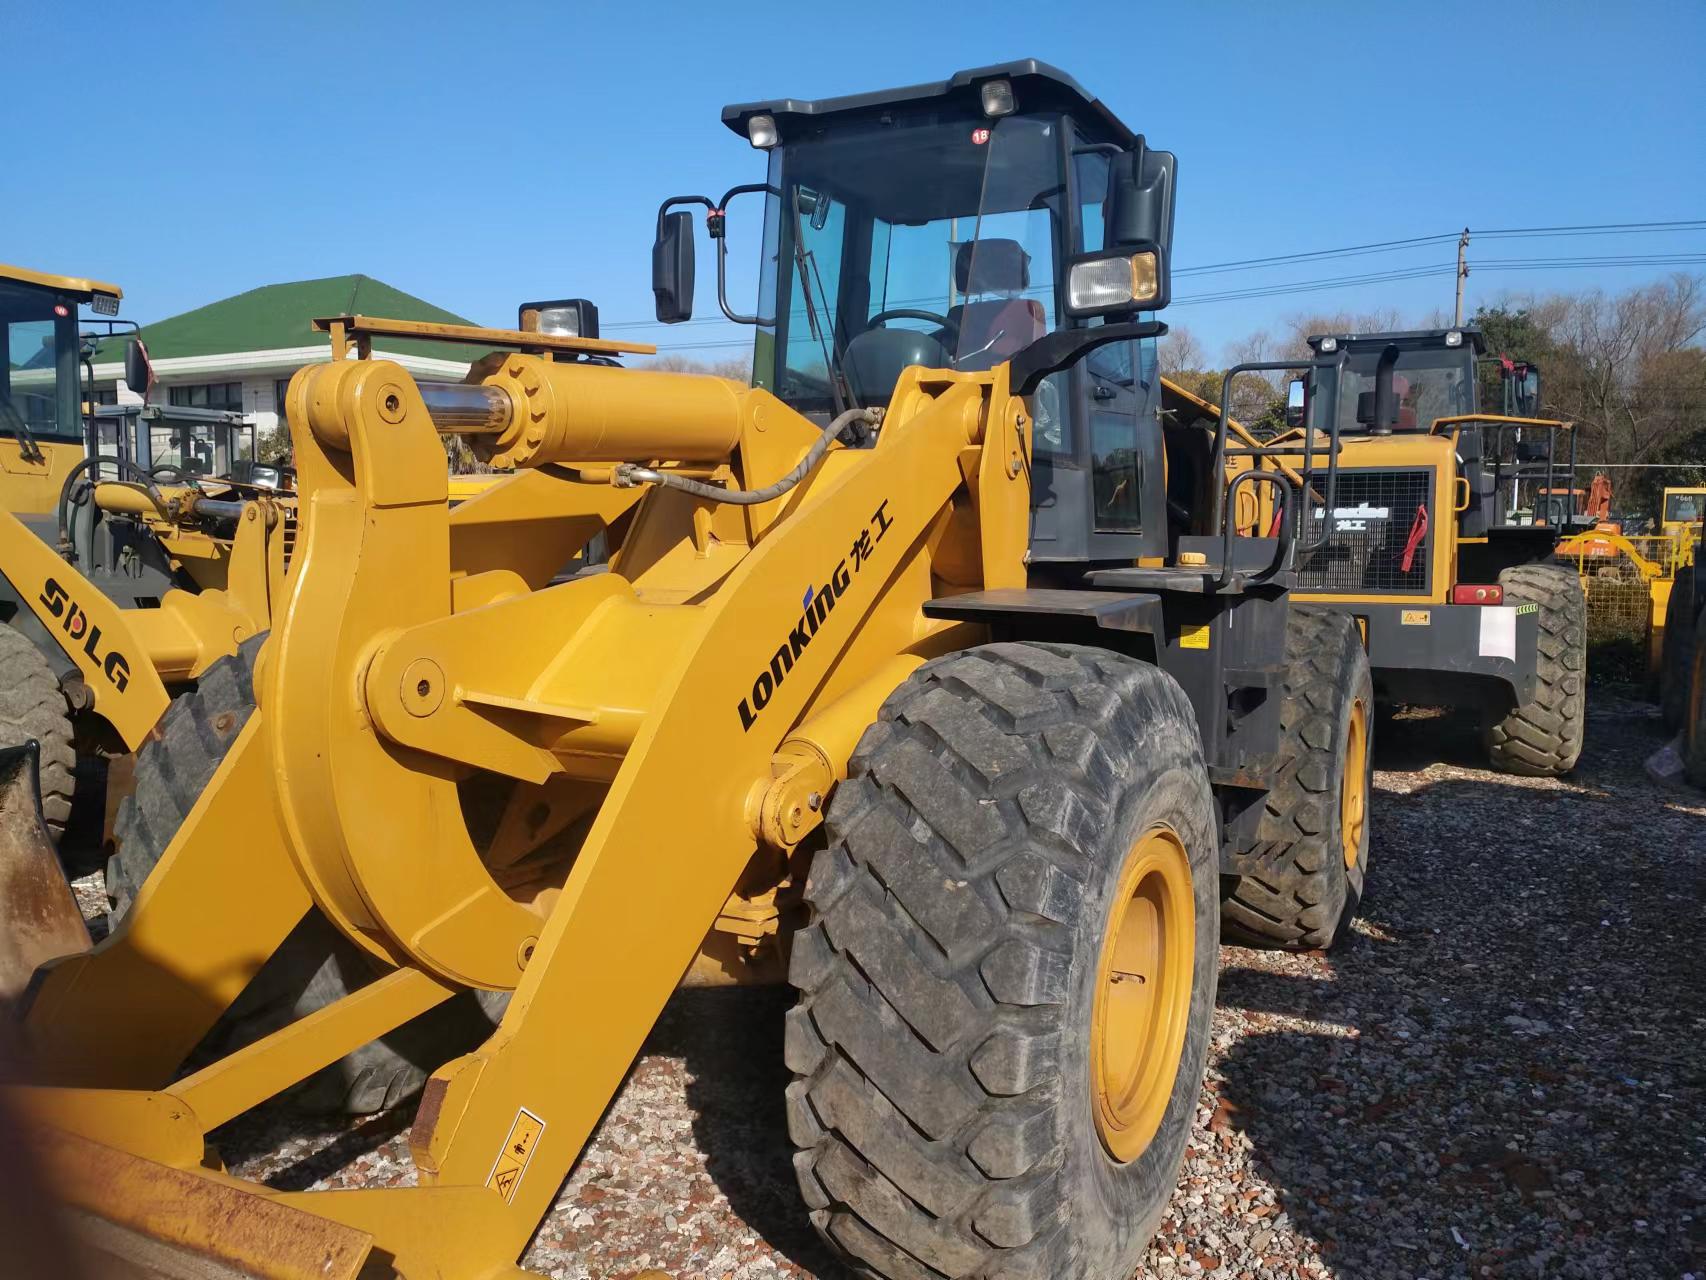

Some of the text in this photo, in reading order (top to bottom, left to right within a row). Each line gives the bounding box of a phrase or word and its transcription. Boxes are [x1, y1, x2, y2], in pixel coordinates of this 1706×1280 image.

[973, 130, 990, 143] 18
[850, 498, 894, 573] 龙工
[39, 577, 131, 695] SDLG
